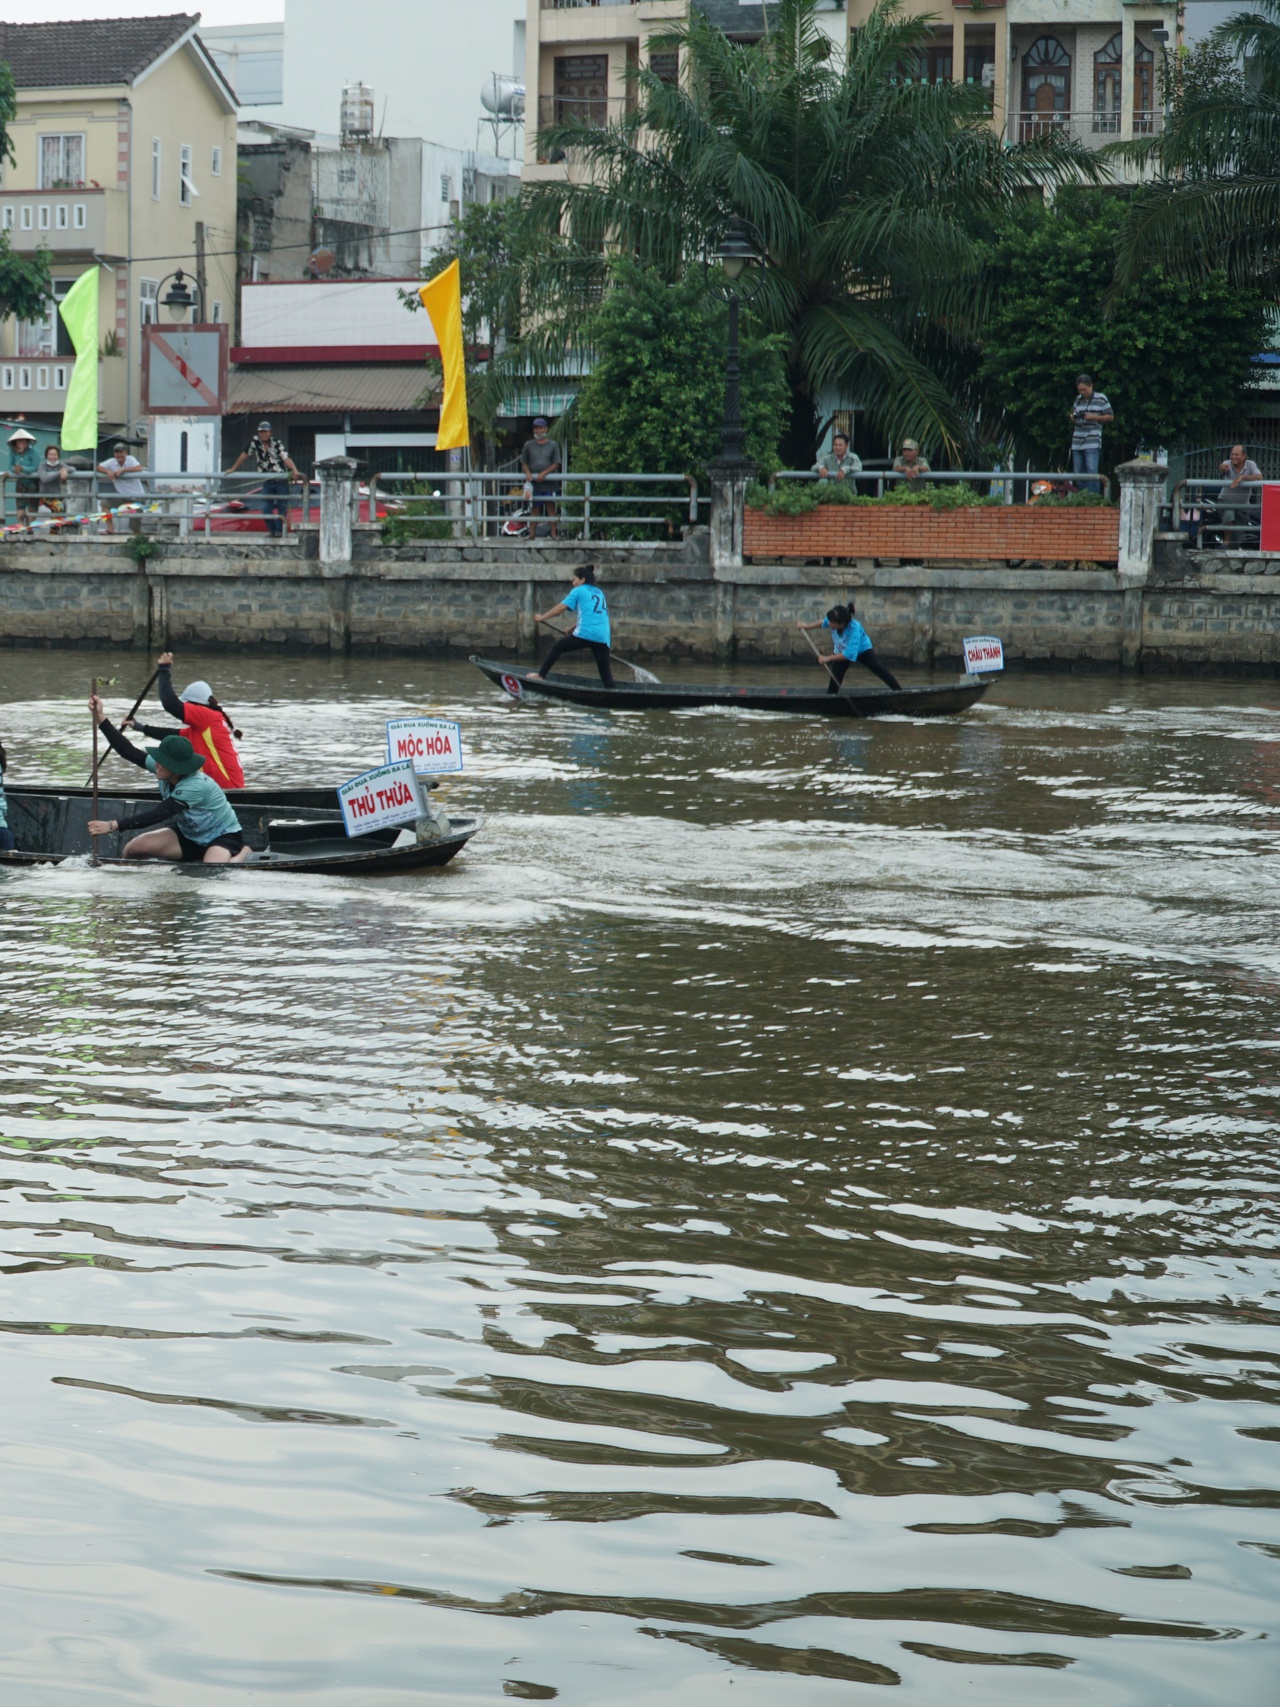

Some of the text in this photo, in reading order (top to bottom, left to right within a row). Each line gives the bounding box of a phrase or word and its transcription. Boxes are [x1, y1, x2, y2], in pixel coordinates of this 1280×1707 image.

[504, 674, 519, 694] 9
[426, 730, 452, 756] HÓA
[355, 778, 368, 788] ĐUA
[348, 780, 414, 818] THỦ THỪA
